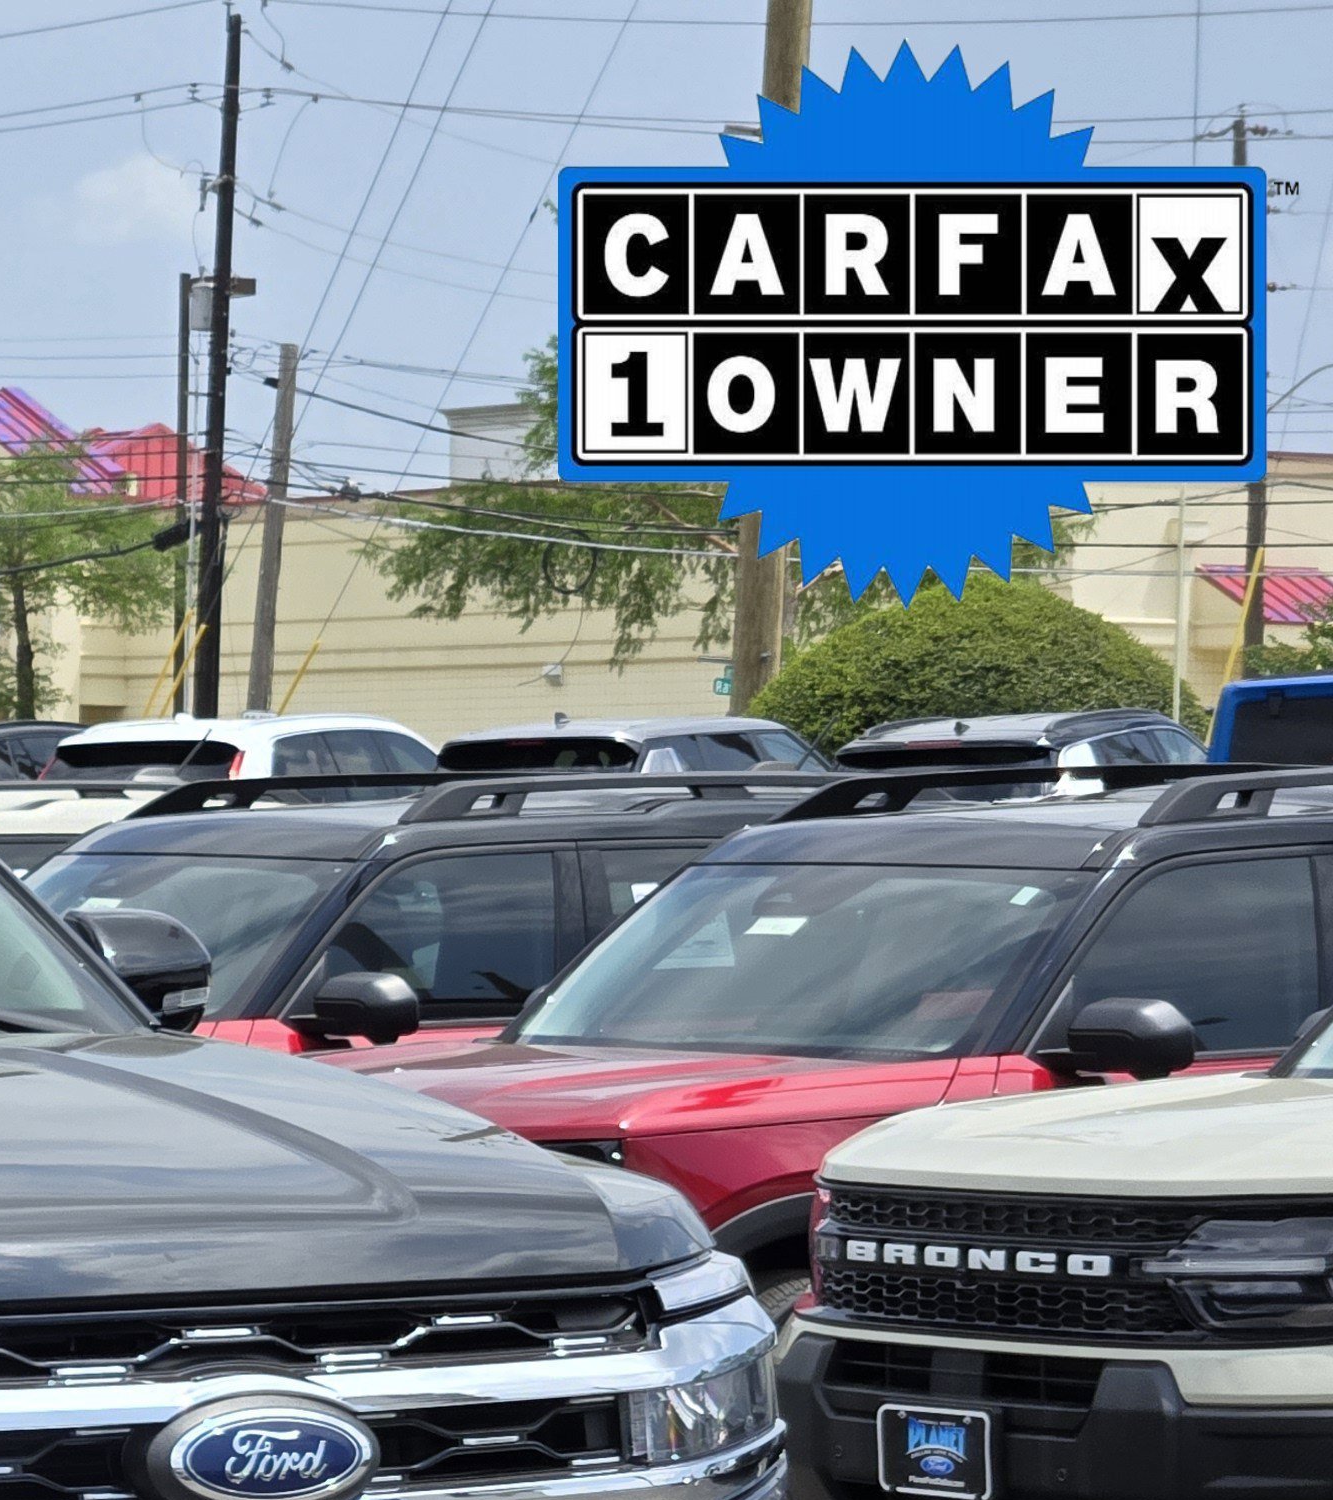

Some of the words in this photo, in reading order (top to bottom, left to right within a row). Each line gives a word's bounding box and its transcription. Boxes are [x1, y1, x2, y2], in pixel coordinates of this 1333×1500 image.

[846, 1238, 1112, 1277] BRONCO
[224, 1428, 329, 1485] Ford
[907, 1416, 966, 1458] PLANET
